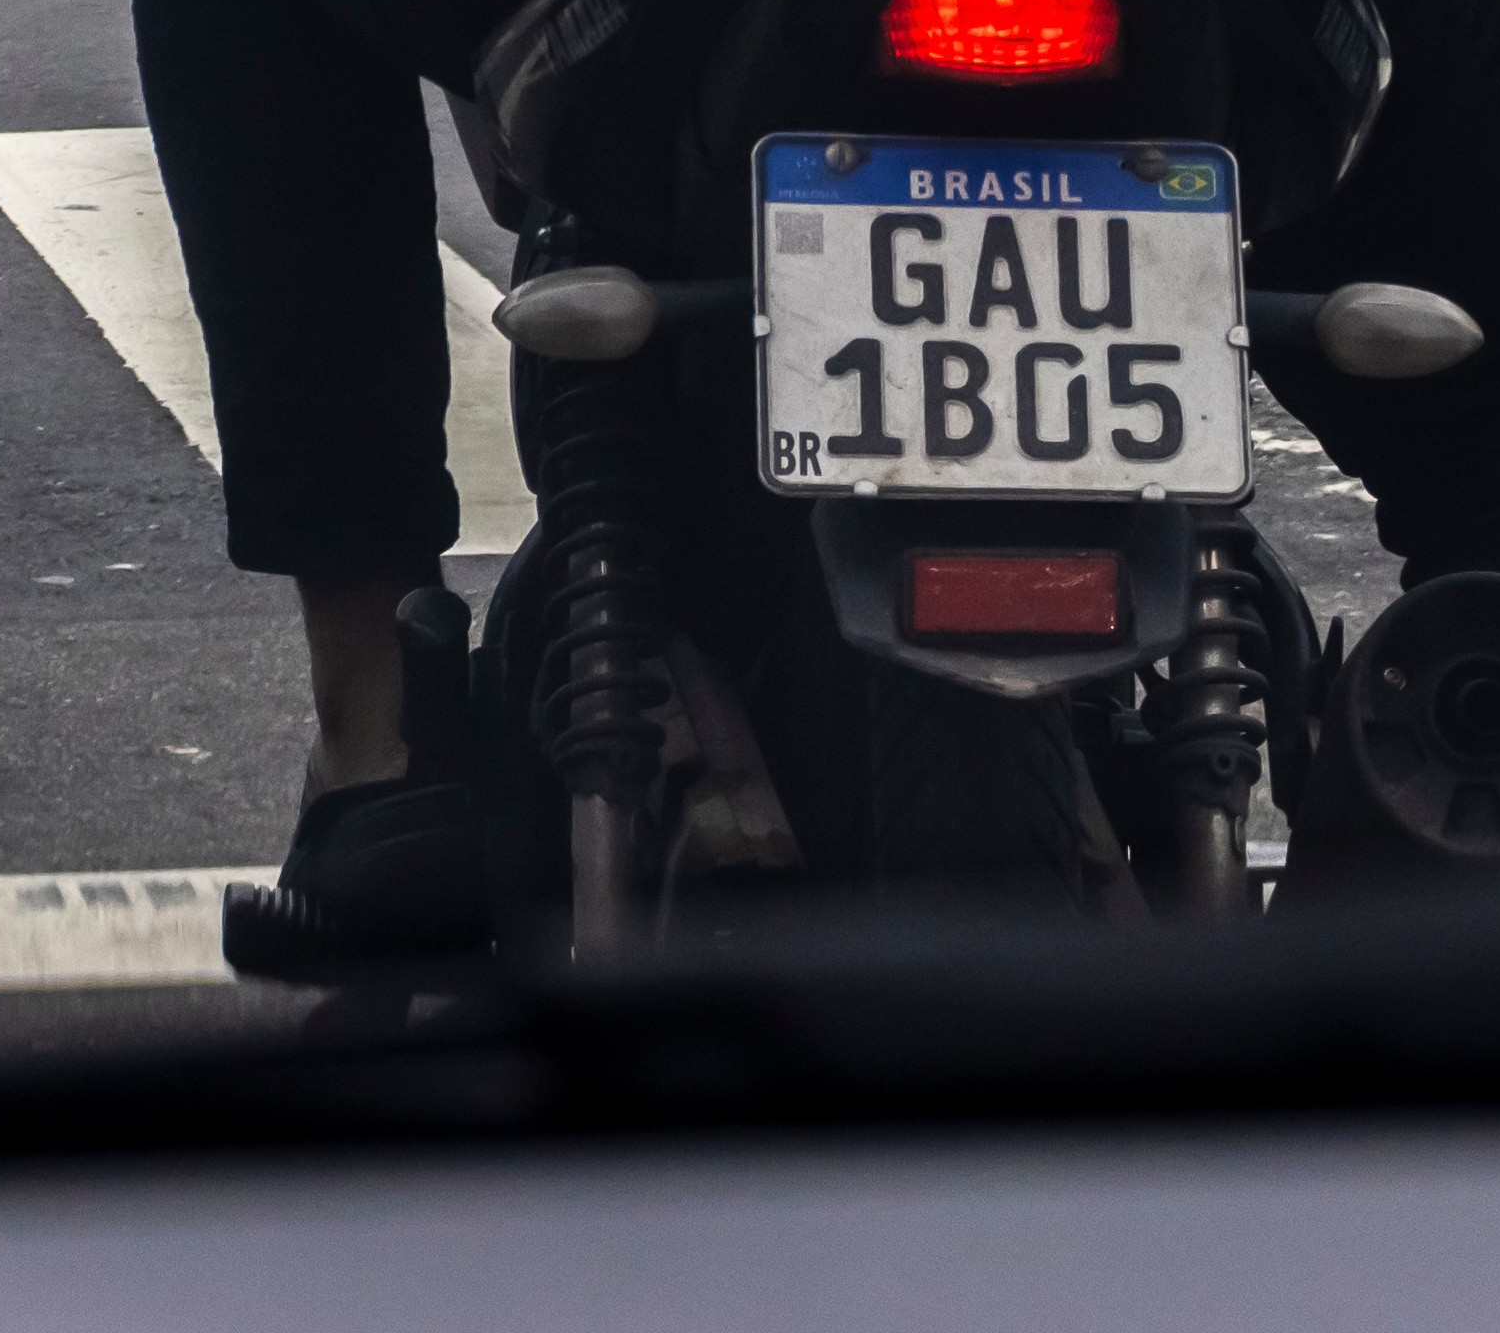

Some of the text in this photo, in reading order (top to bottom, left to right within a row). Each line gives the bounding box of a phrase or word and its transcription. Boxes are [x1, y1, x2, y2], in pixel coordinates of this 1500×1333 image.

[910, 169, 1084, 204] BRASIL
[869, 212, 1134, 330] GAU
[824, 337, 1186, 464] 1B05
[772, 429, 823, 478] BR
